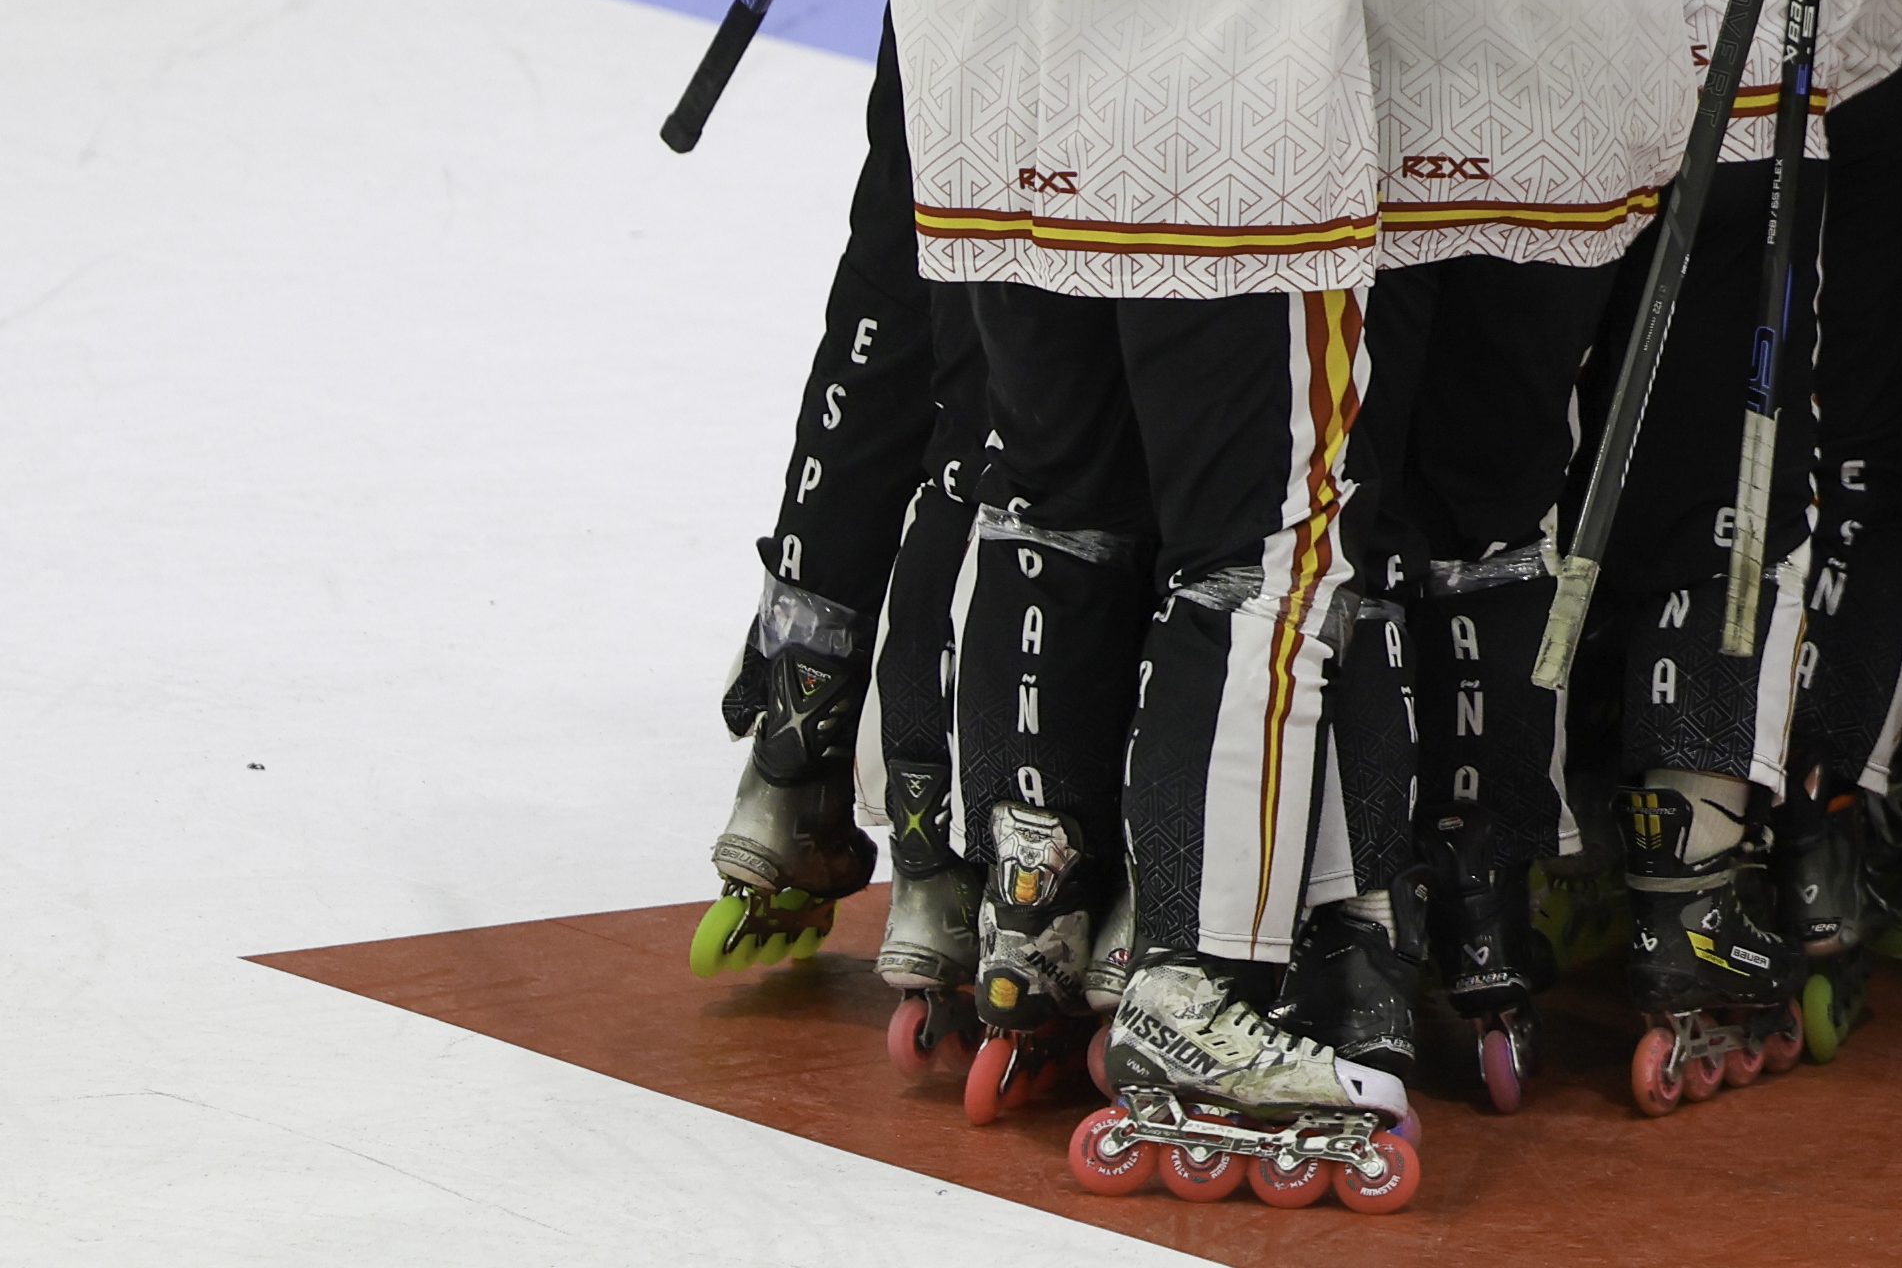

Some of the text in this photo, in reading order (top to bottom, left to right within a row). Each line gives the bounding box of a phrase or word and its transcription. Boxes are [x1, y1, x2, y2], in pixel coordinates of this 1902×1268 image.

[1773, 157, 1785, 188] FLEX
[1733, 947, 1769, 968] BAUER
[1116, 999, 1219, 1076] MISSION
[1098, 1150, 1140, 1176] MAVERICK
